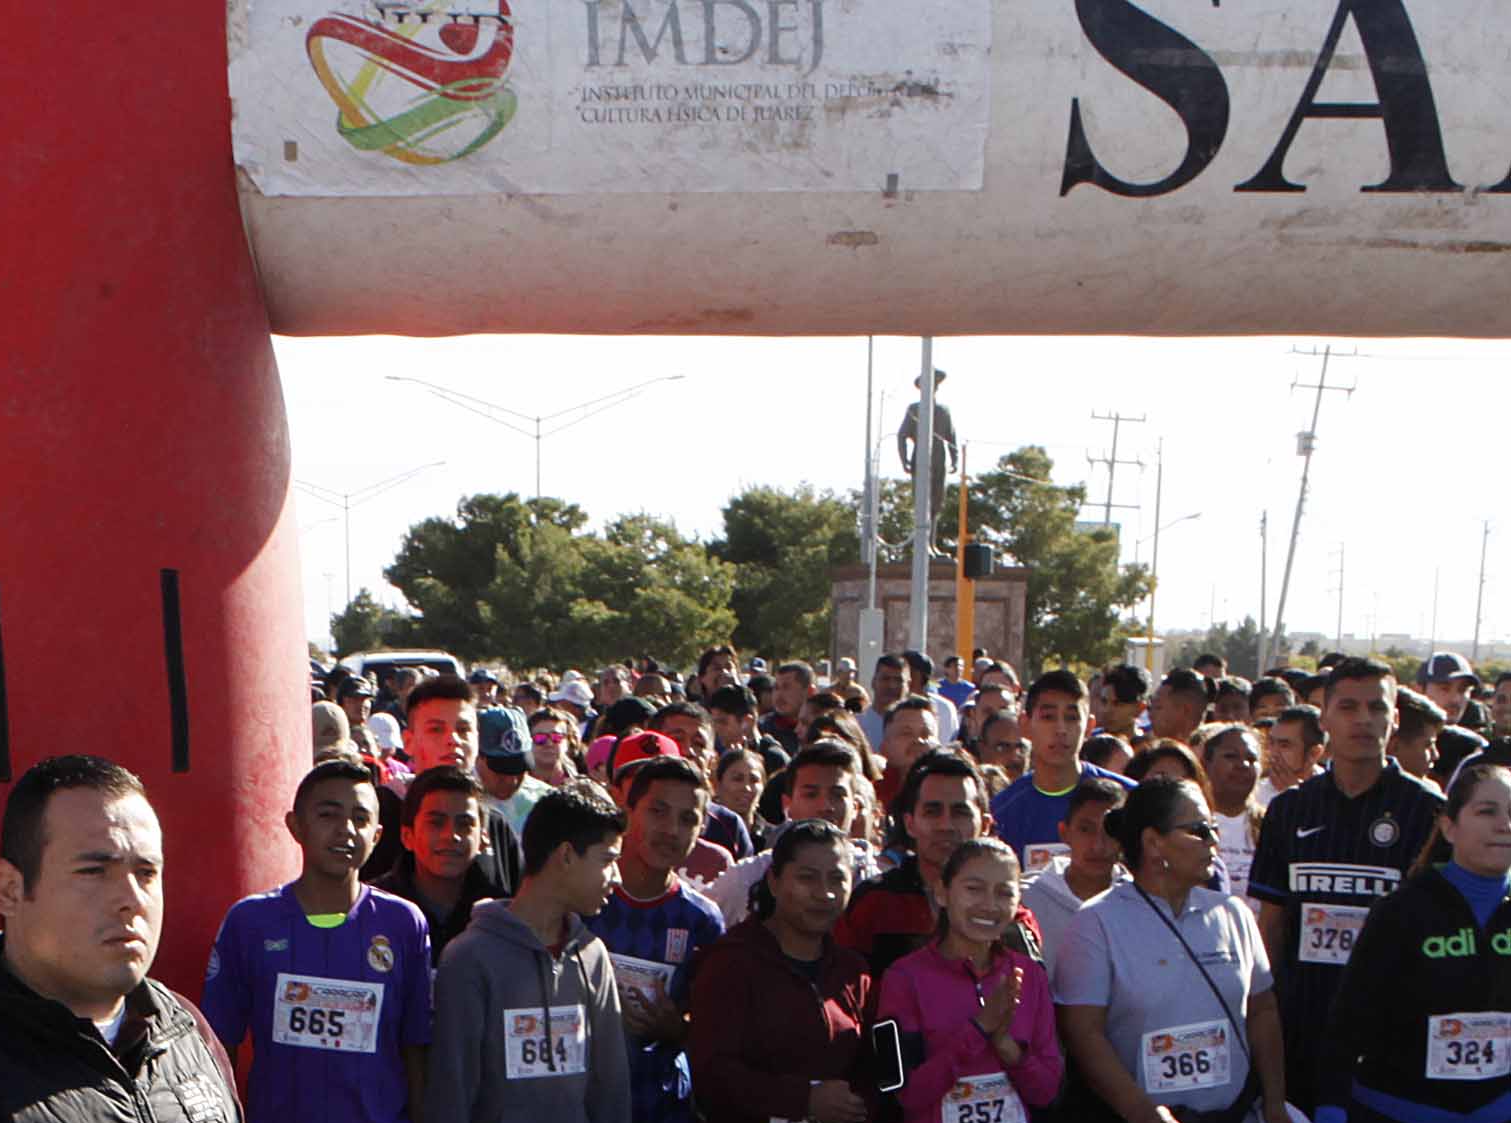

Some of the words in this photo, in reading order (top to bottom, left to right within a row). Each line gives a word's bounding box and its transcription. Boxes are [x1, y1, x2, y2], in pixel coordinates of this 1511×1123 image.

[584, 0, 824, 78] IMDEJ
[685, 82, 782, 101] MUNICIPAL
[1060, 0, 1511, 198] SA
[581, 107, 663, 124] CULTURA
[289, 1006, 345, 1037] 665
[1161, 1050, 1210, 1079] 366
[1445, 1040, 1494, 1065] 324
